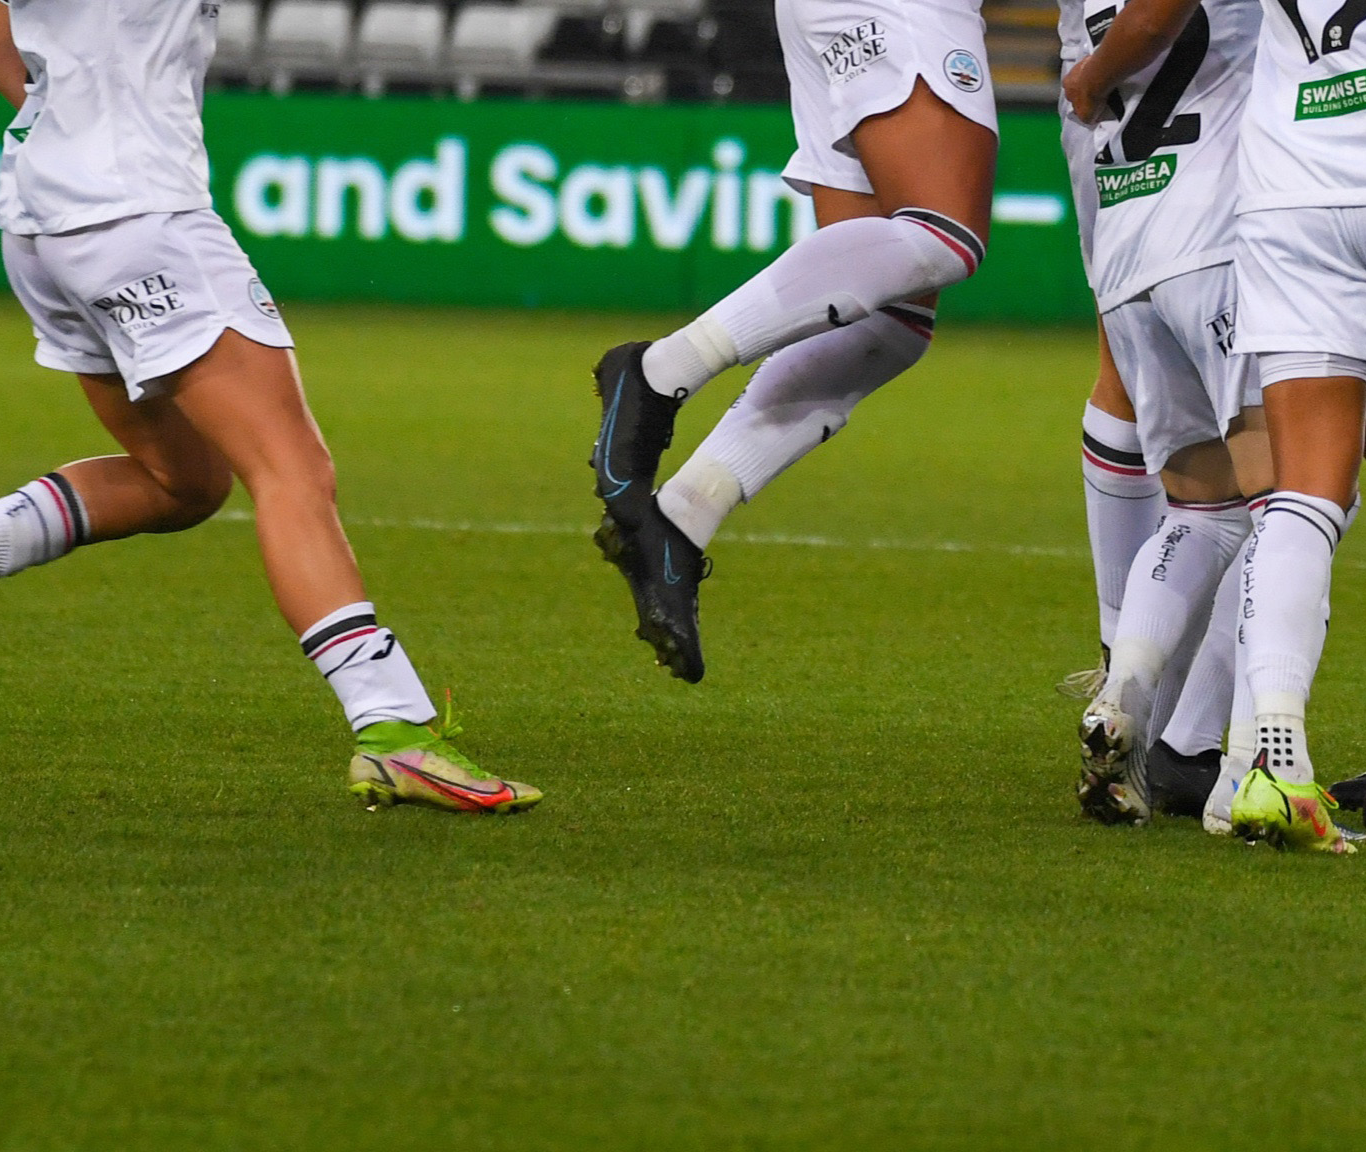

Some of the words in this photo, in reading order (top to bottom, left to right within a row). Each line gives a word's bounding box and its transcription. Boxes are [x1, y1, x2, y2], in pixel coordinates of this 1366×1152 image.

[1302, 101, 1342, 115] BUILDING
[233, 136, 468, 246] and
[1130, 179, 1167, 193] SOCIETY
